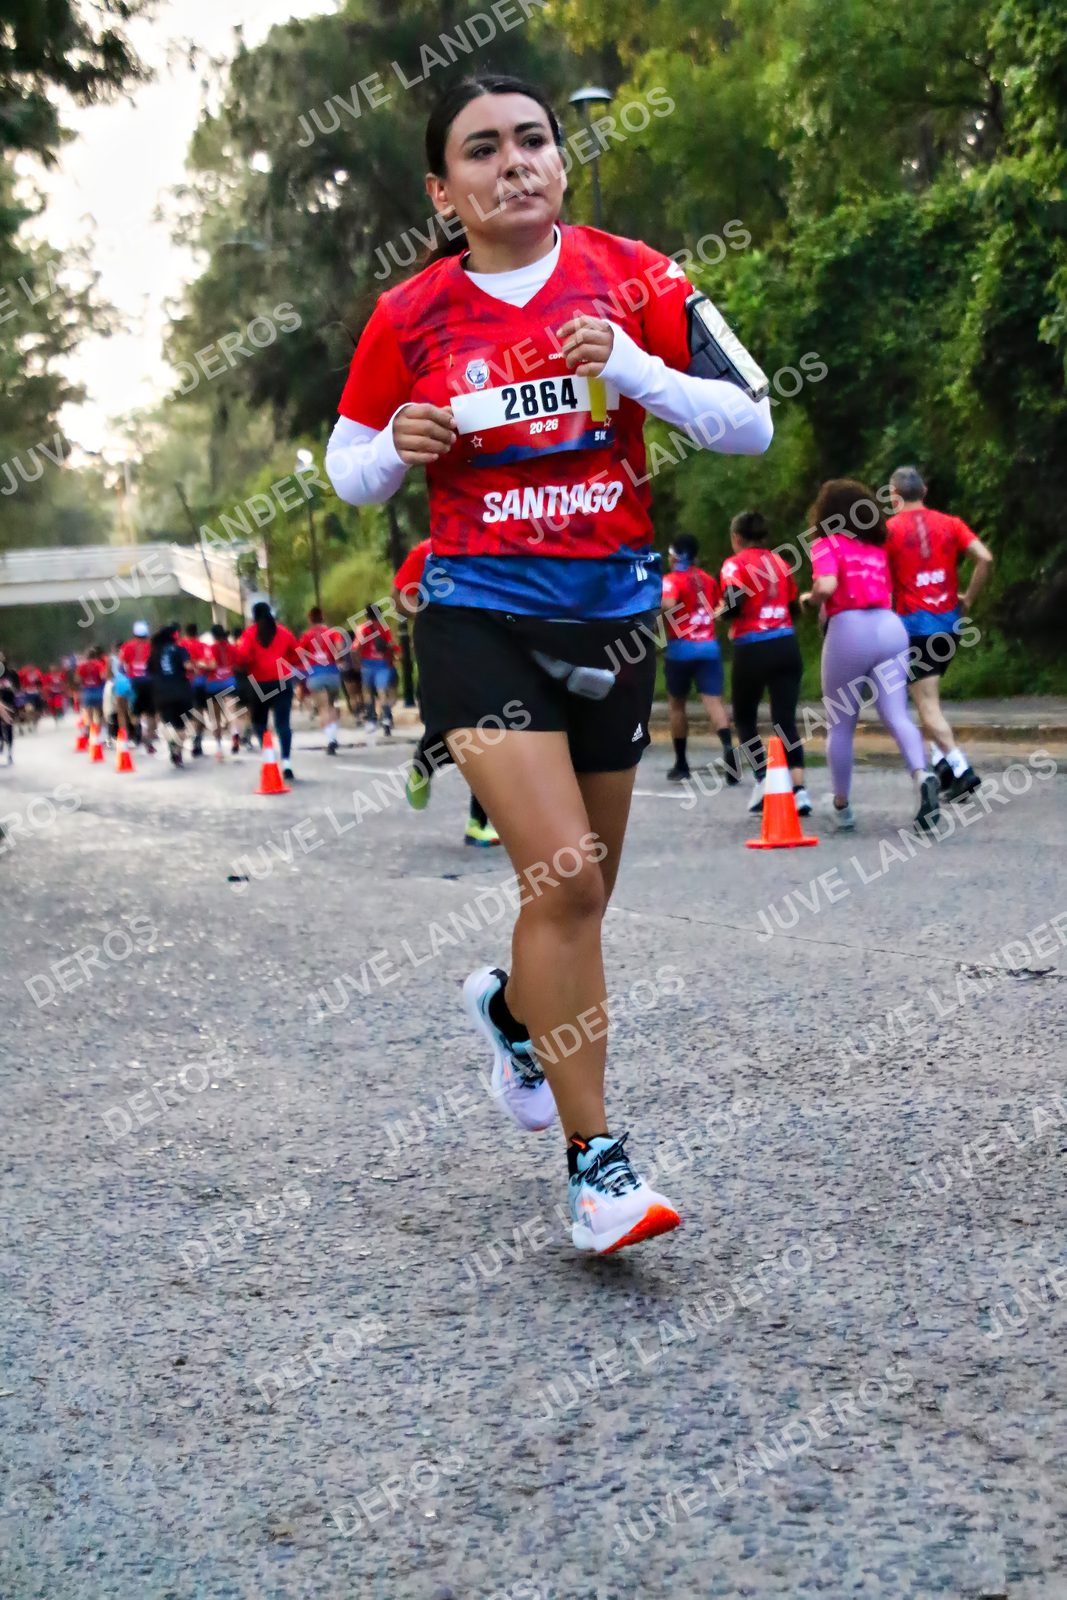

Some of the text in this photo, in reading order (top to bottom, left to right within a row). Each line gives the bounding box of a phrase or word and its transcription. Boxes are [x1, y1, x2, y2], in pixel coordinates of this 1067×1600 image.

[502, 378, 578, 421] 2864
[594, 430, 607, 441] 5K
[482, 481, 624, 523] SANTIAGO
